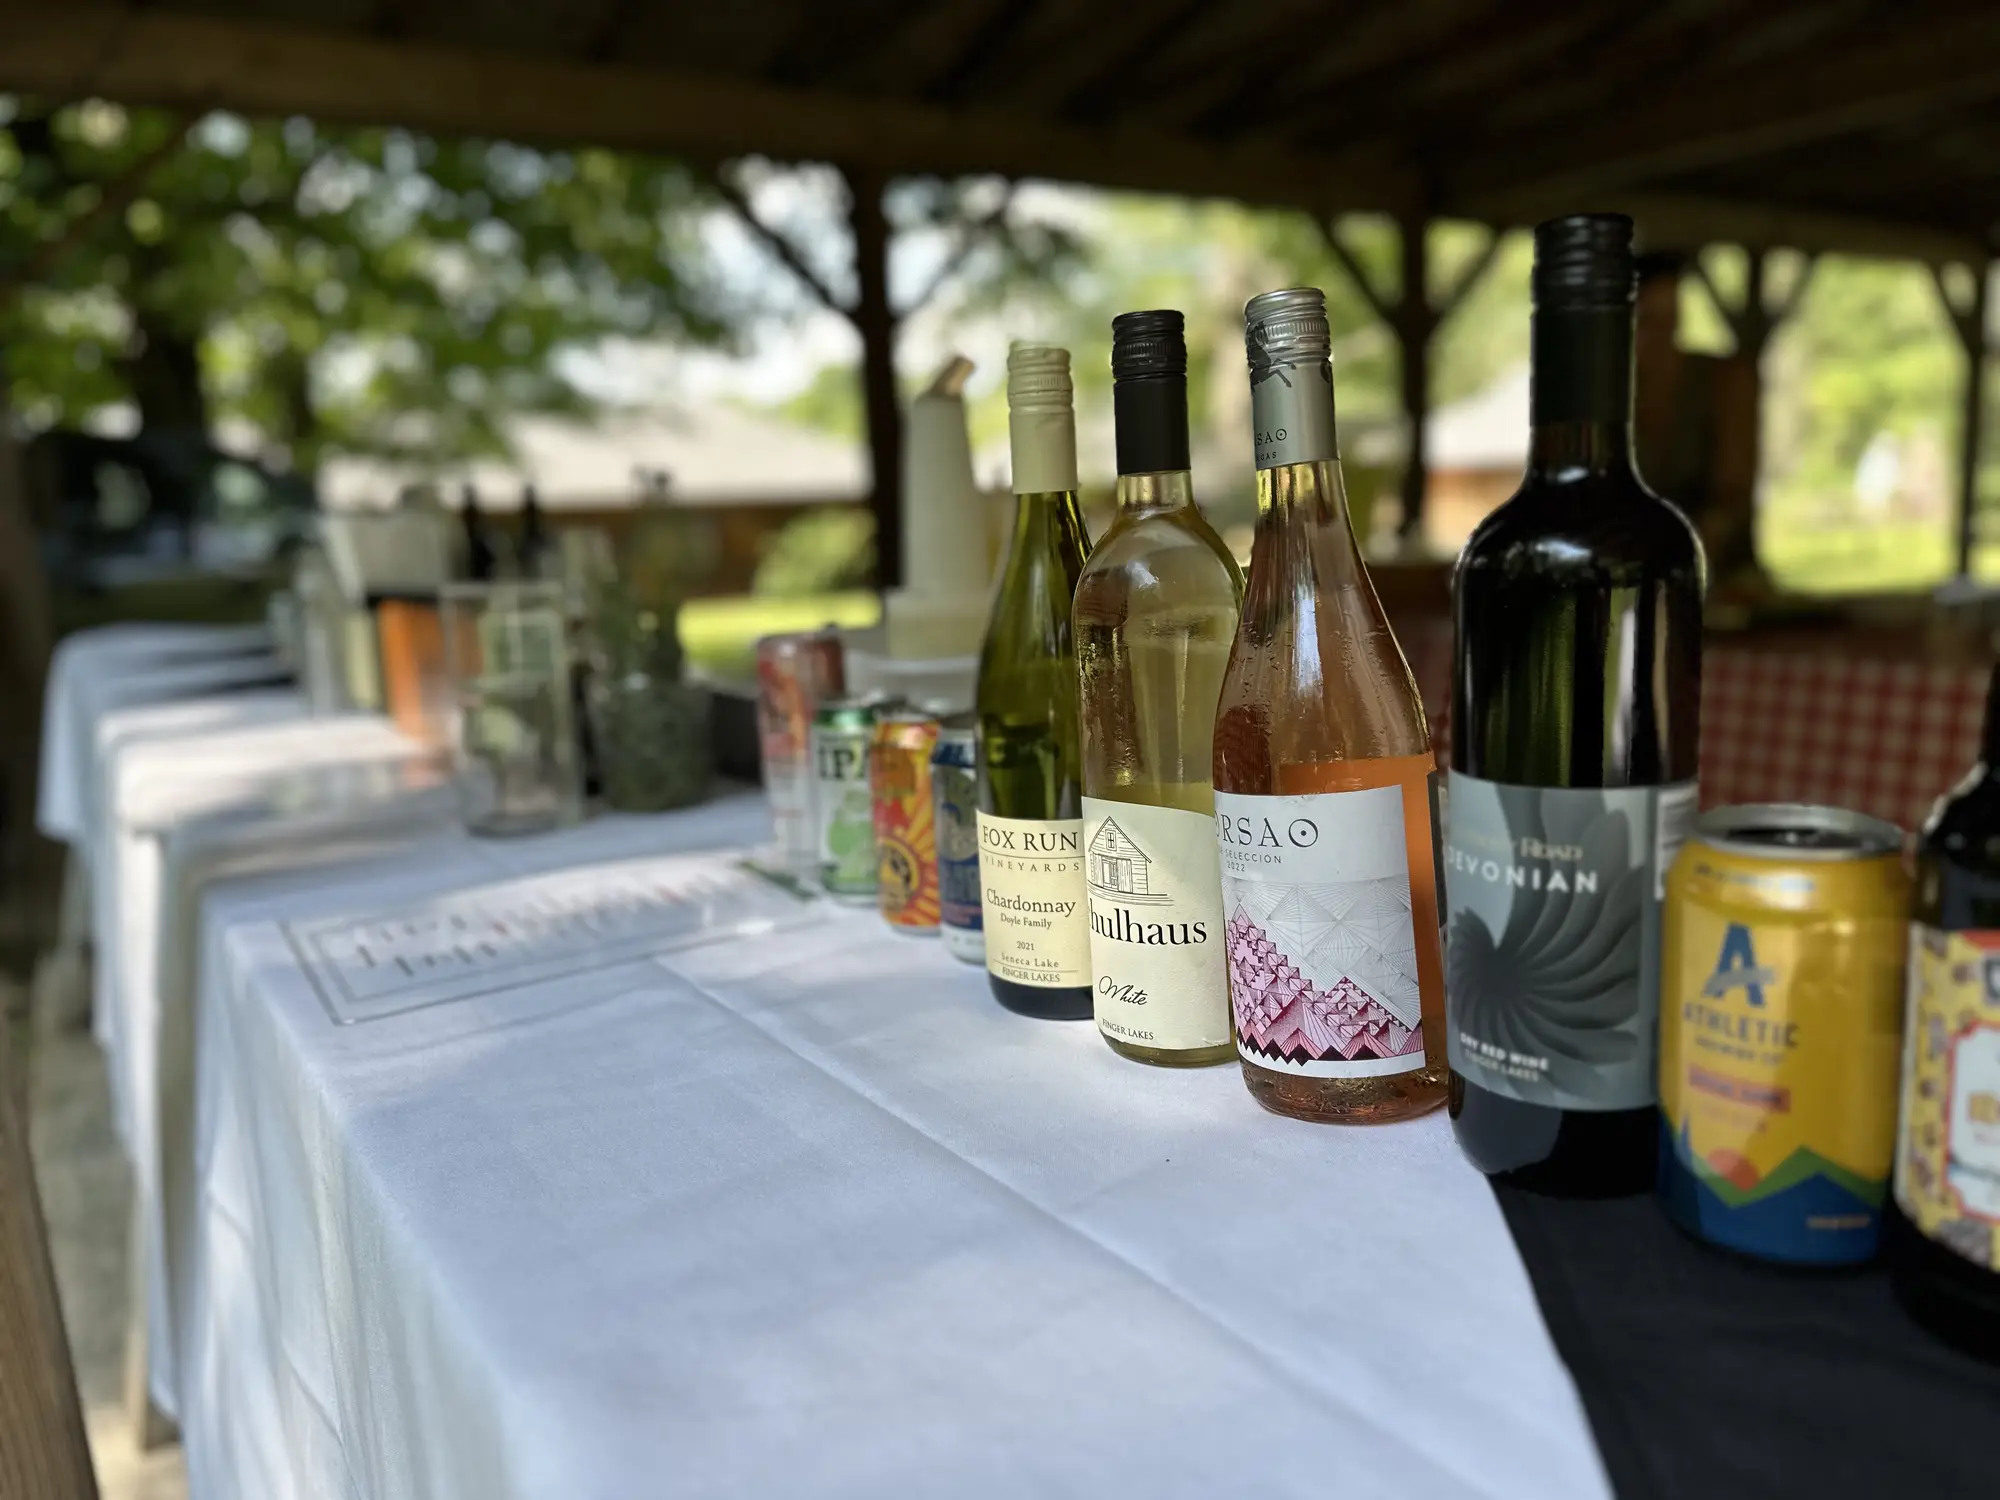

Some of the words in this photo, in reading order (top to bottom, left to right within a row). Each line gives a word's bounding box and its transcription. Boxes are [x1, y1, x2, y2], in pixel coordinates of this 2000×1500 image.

[1254, 428, 1287, 446] SAO
[982, 824, 1016, 850] FOX
[1022, 831, 1079, 852] RUN
[984, 855, 1080, 873] VINEYARDS
[1225, 848, 1282, 864] SELECCION
[1226, 860, 1246, 873] 2022
[986, 887, 1077, 918] Chardonnay
[1000, 912, 1022, 927] Doyle
[1023, 917, 1053, 930] Family
[1090, 897, 1208, 946] hulhaus
[1016, 940, 1036, 951] 2021
[1001, 951, 1031, 966] Seneca
[1034, 957, 1060, 968] Lake
[1002, 966, 1030, 981] FINGER
[1031, 971, 1061, 983] LAKES
[1098, 975, 1149, 1006] White
[1102, 1018, 1126, 1036] FINGER
[1128, 1028, 1155, 1041] LAKES
[1682, 1001, 1800, 1050] ATHLETIC
[1481, 1042, 1507, 1062] RED
[1508, 1051, 1549, 1073] WINE
